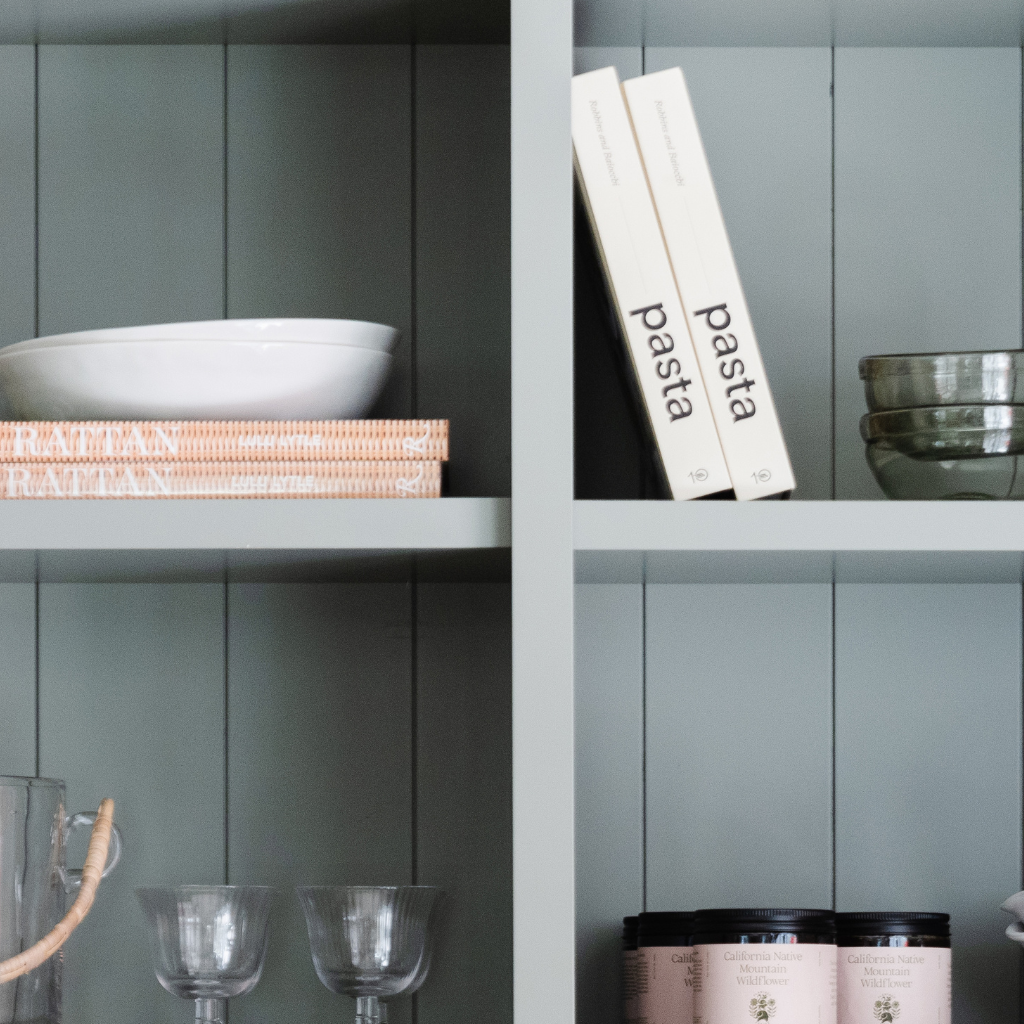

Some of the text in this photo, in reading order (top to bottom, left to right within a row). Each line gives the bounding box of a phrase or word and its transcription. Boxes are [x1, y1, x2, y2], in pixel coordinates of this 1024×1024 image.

[628, 302, 693, 423] pasta
[692, 302, 756, 424] pasta
[12, 425, 180, 456] RATTAN
[238, 434, 275, 447] LULU
[279, 433, 322, 447] LYTLE
[6, 466, 172, 497] RATTAN
[231, 474, 268, 487] LULU
[271, 474, 315, 488] LYTLE
[723, 950, 803, 961] California Native
[847, 953, 925, 964] California Native
[739, 963, 787, 974] Mountain
[863, 966, 910, 976] Mountain
[736, 975, 790, 986] Wildflower
[860, 978, 913, 988] Wildflower
